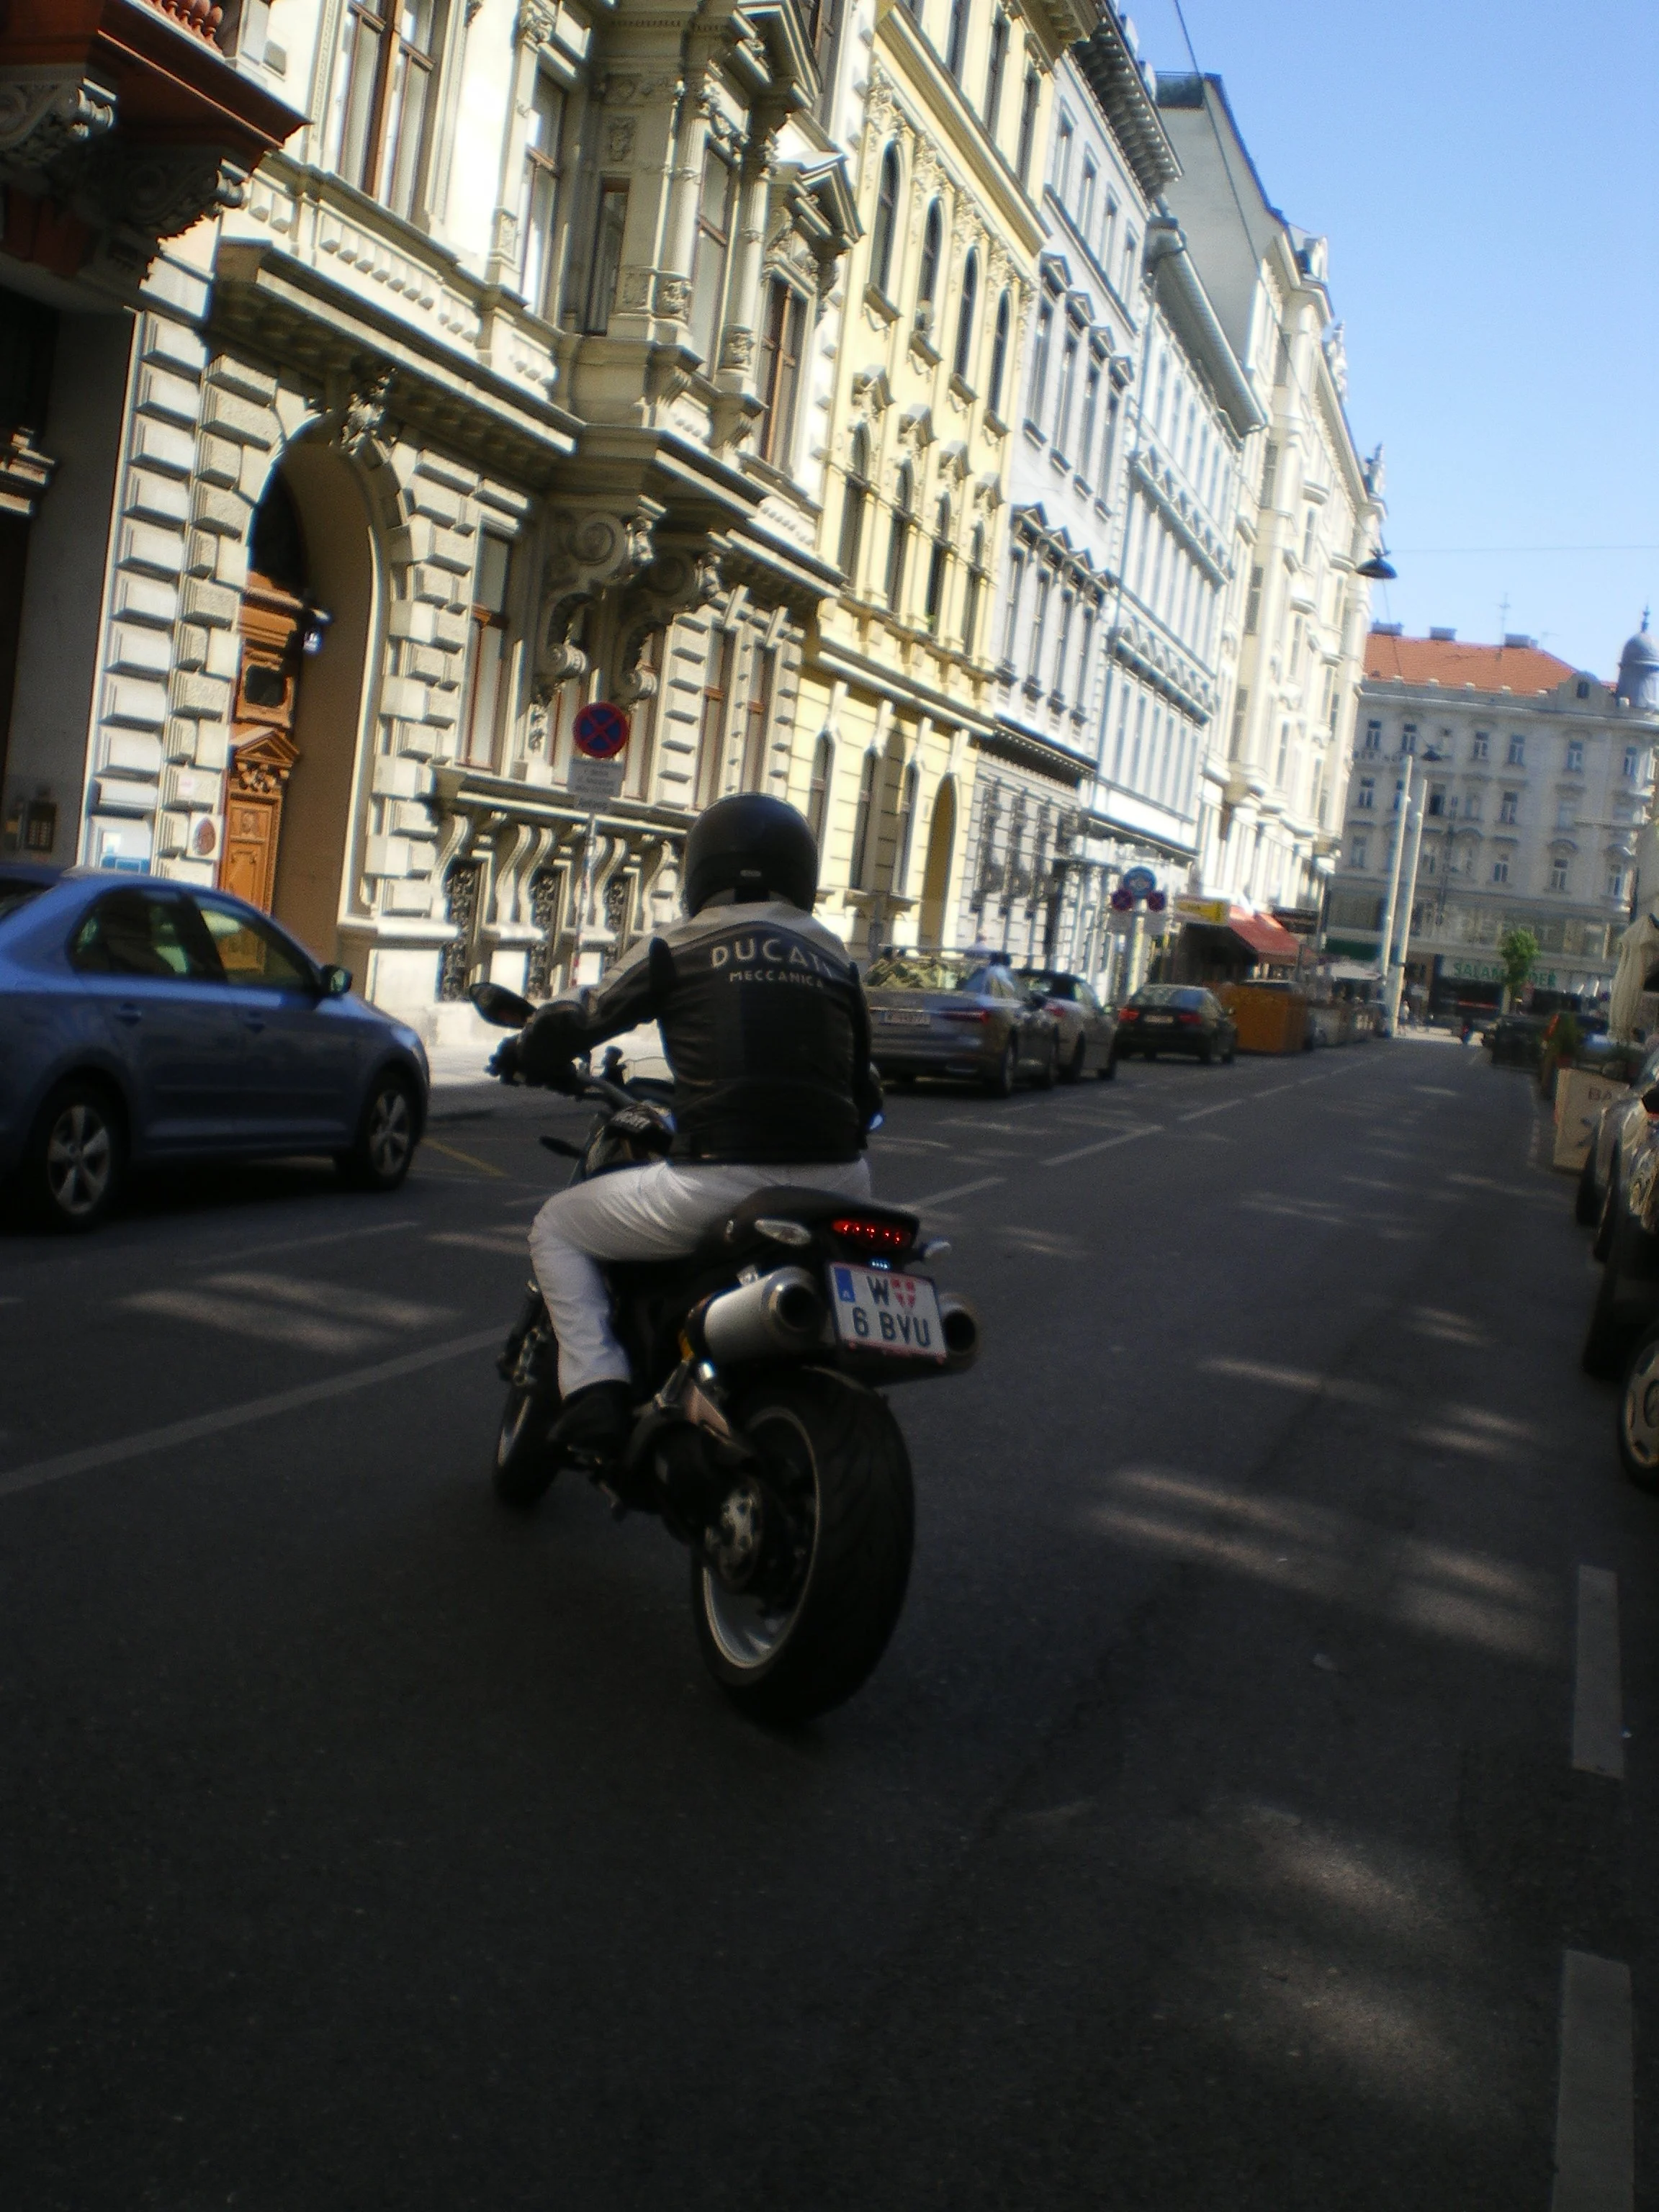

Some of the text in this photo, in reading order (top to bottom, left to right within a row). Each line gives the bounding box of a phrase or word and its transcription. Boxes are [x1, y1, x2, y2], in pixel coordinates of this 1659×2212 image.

[729, 969, 824, 989] MECCANICA
[866, 1276, 889, 1306] W
[853, 1307, 930, 1347] 6 BVU
